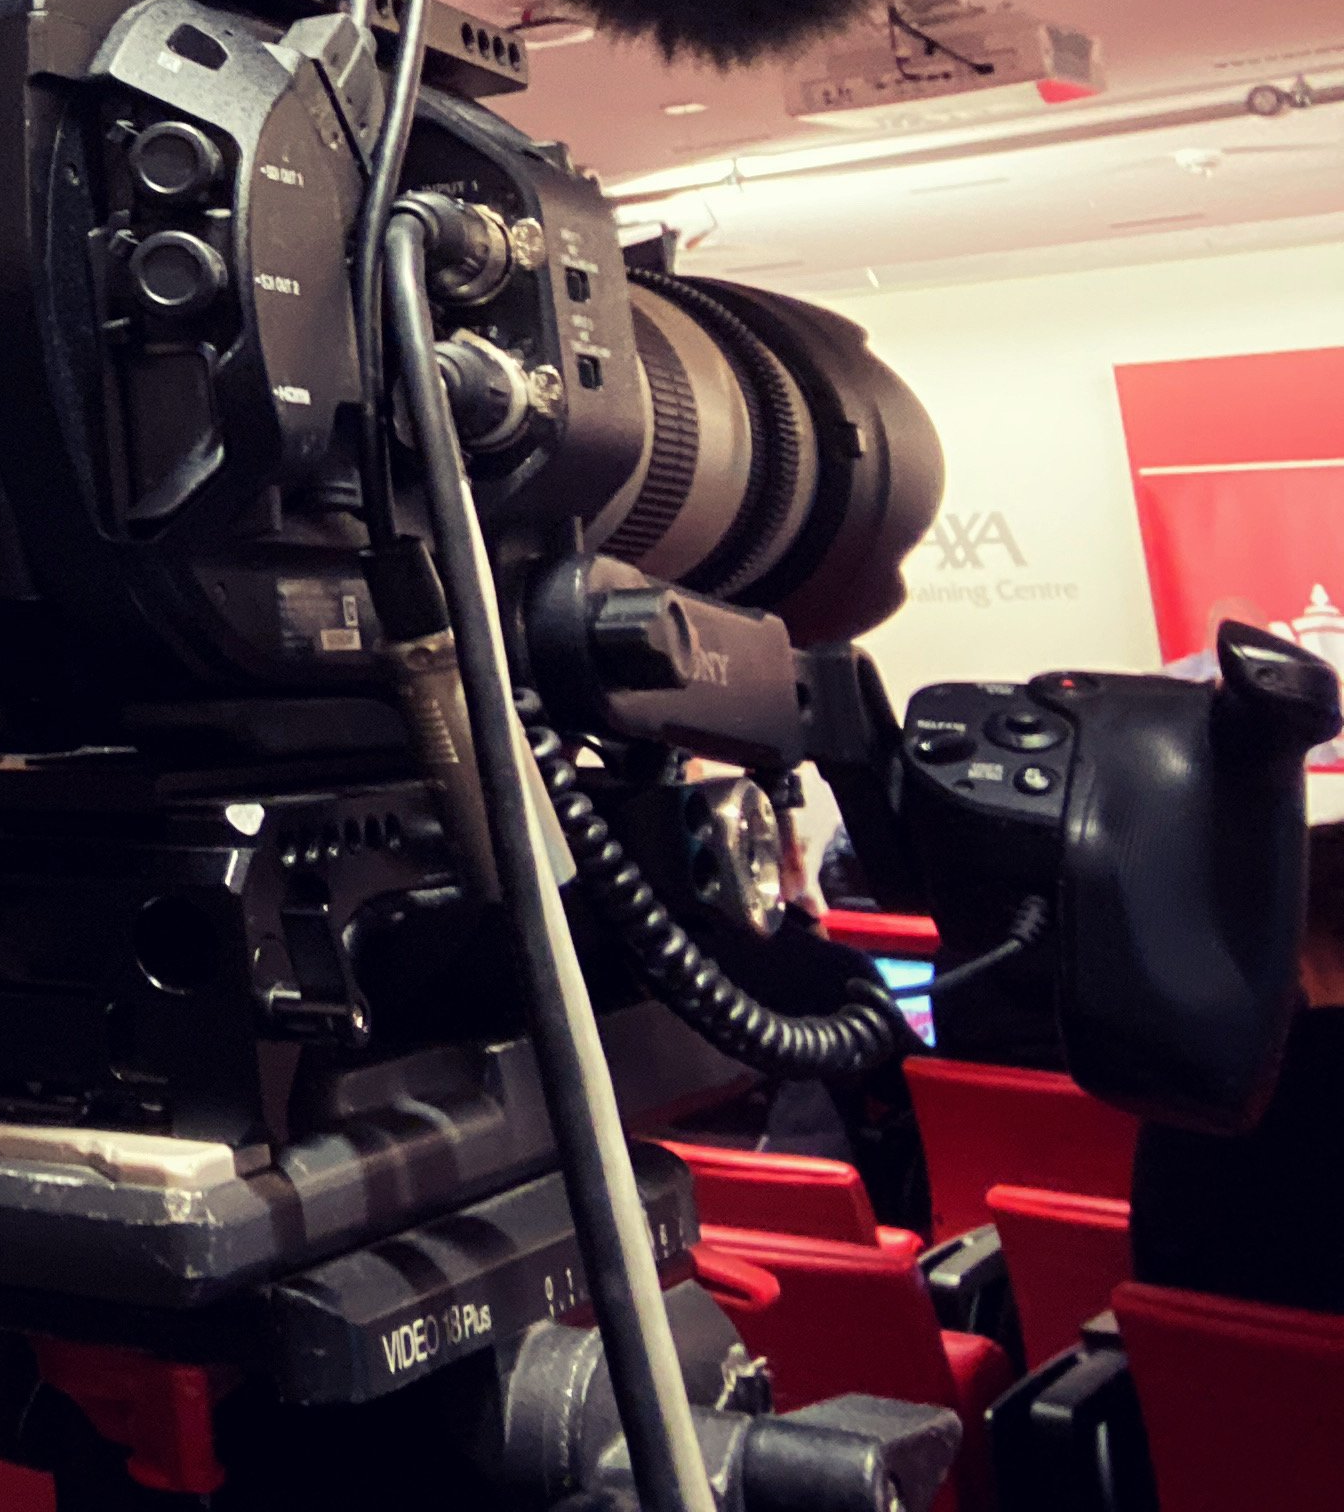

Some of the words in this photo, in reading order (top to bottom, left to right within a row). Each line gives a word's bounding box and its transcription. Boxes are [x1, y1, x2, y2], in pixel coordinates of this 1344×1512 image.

[909, 581, 992, 609] raining
[996, 579, 1080, 601] Centre
[381, 1317, 440, 1375] VIDEO
[462, 1303, 493, 1340] Plus
